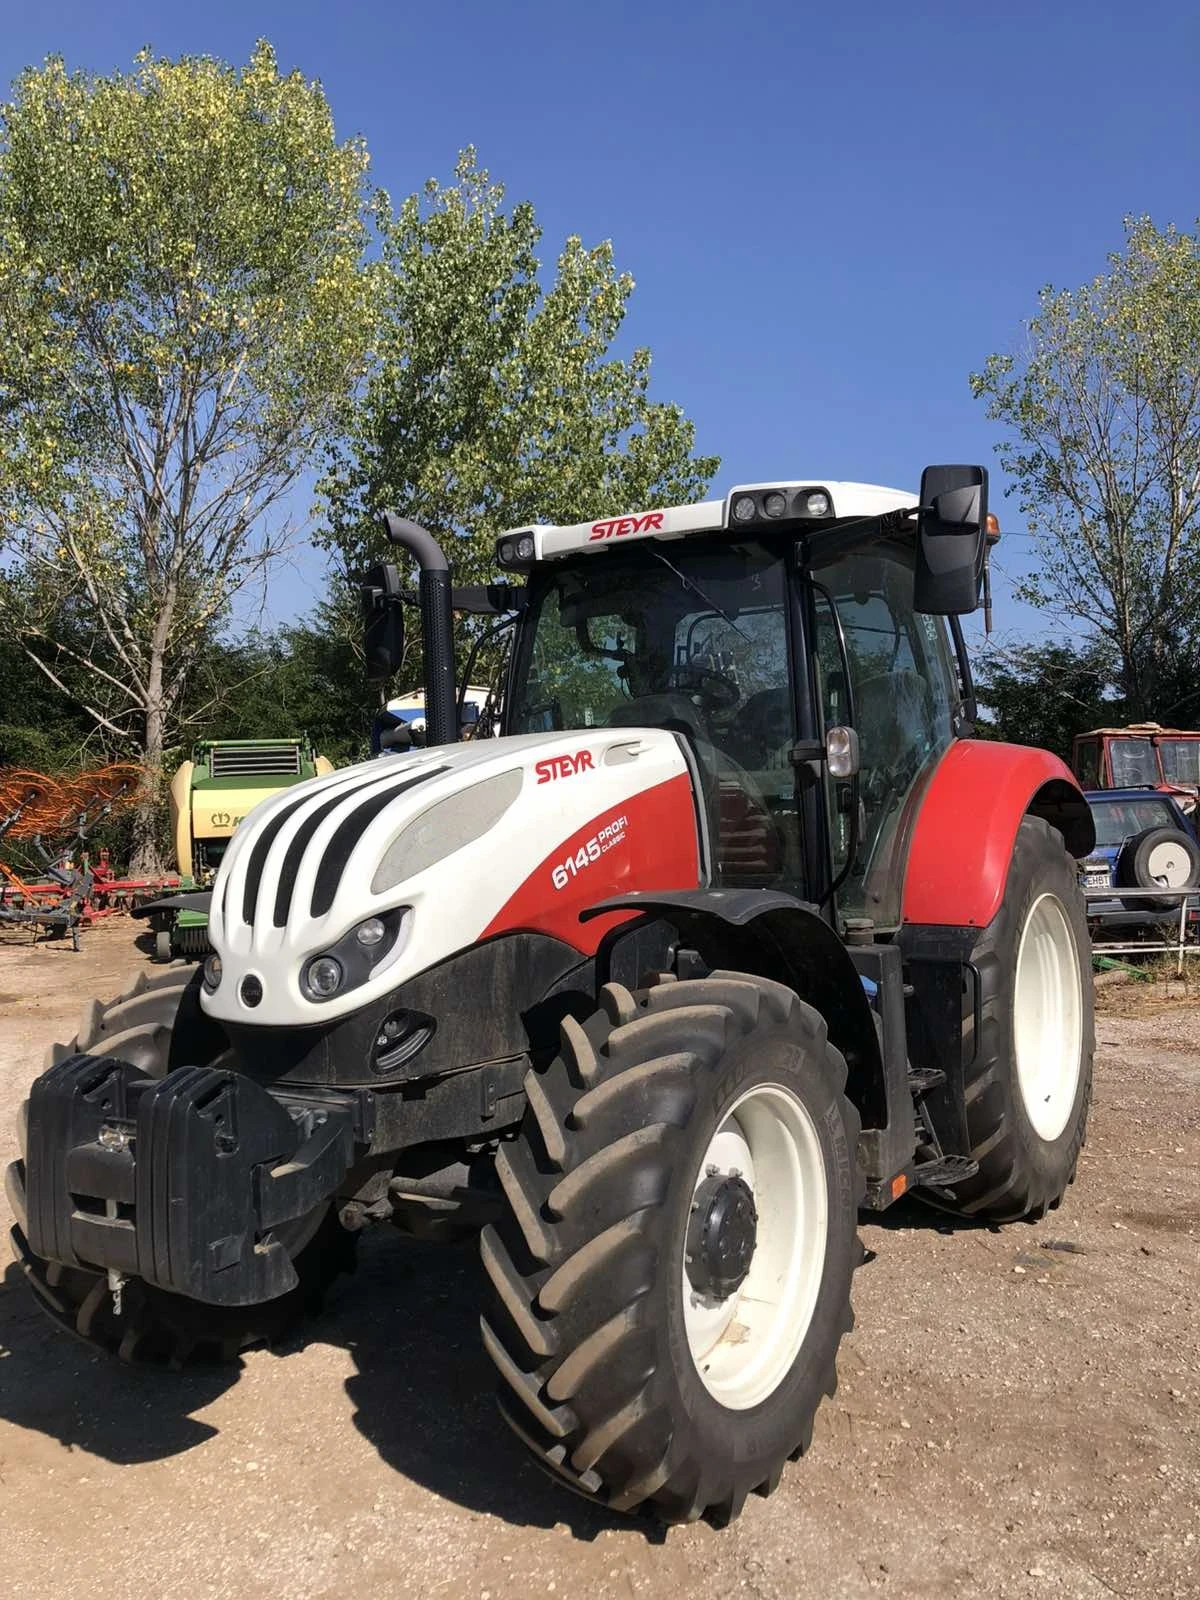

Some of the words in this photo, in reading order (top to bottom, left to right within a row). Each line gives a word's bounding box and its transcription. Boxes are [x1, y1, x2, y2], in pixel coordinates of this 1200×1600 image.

[589, 513, 664, 541] STEYR
[535, 750, 595, 784] STEYR
[551, 837, 602, 890] 6145
[598, 815, 628, 843] PROFI
[601, 831, 626, 853] CLASSIC
